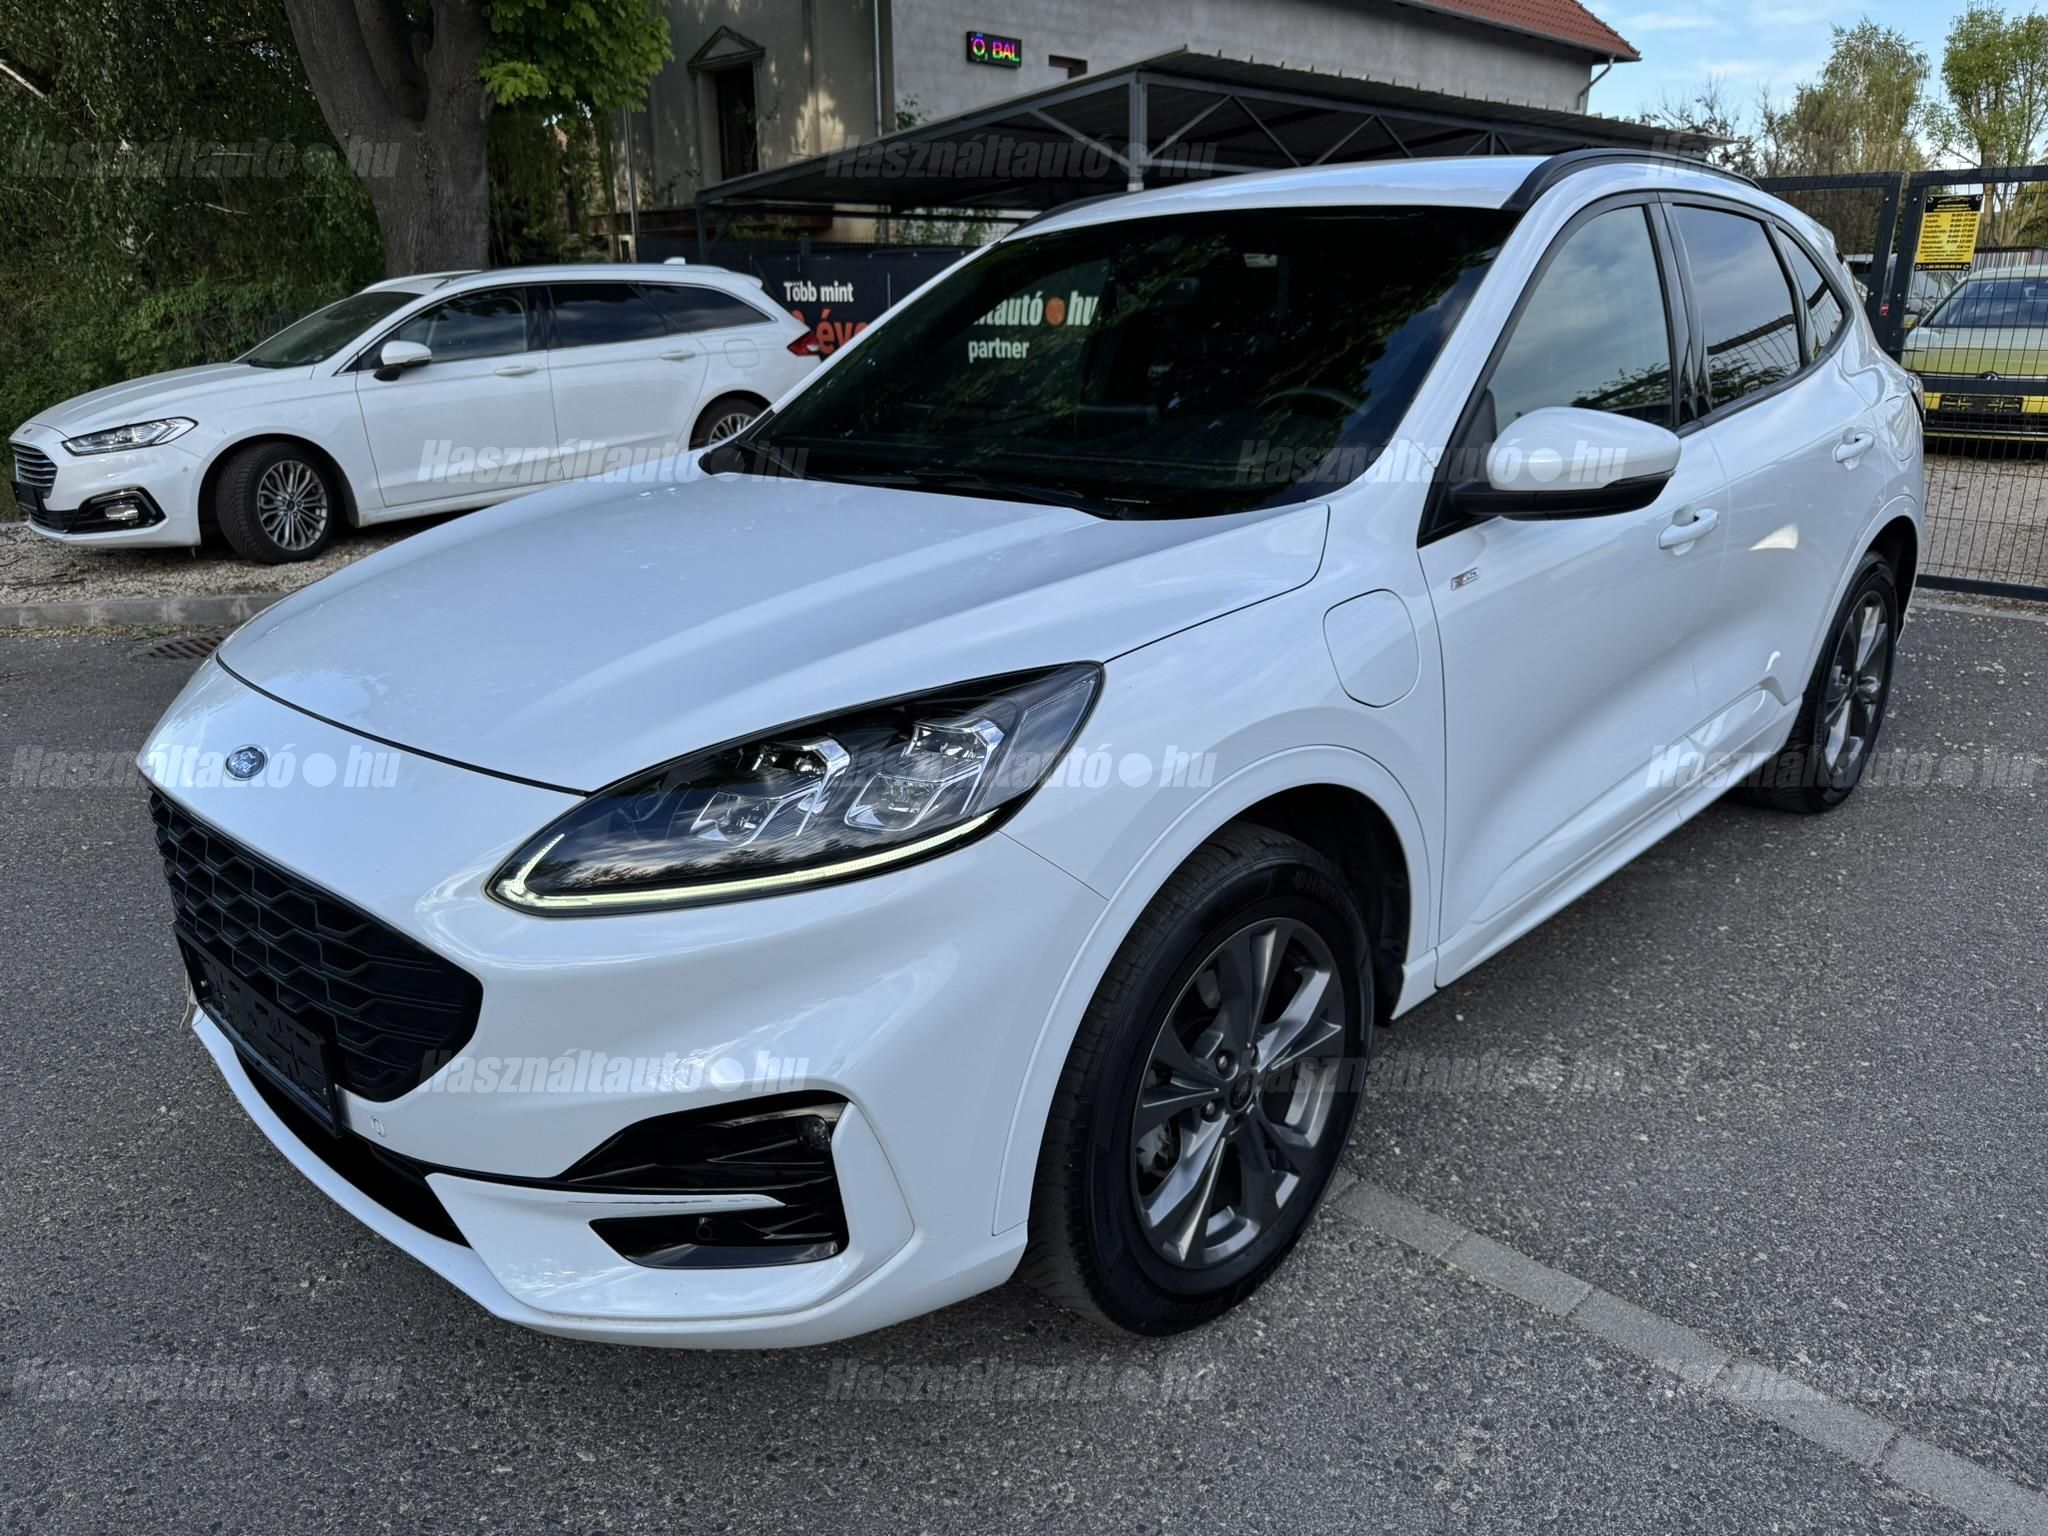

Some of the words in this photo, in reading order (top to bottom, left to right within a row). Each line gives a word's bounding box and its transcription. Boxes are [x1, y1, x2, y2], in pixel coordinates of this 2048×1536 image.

[992, 40, 1021, 62] BAL
[783, 280, 817, 302] Több
[820, 280, 854, 302] mint
[816, 308, 869, 354] év
[968, 337, 1030, 363] partner
